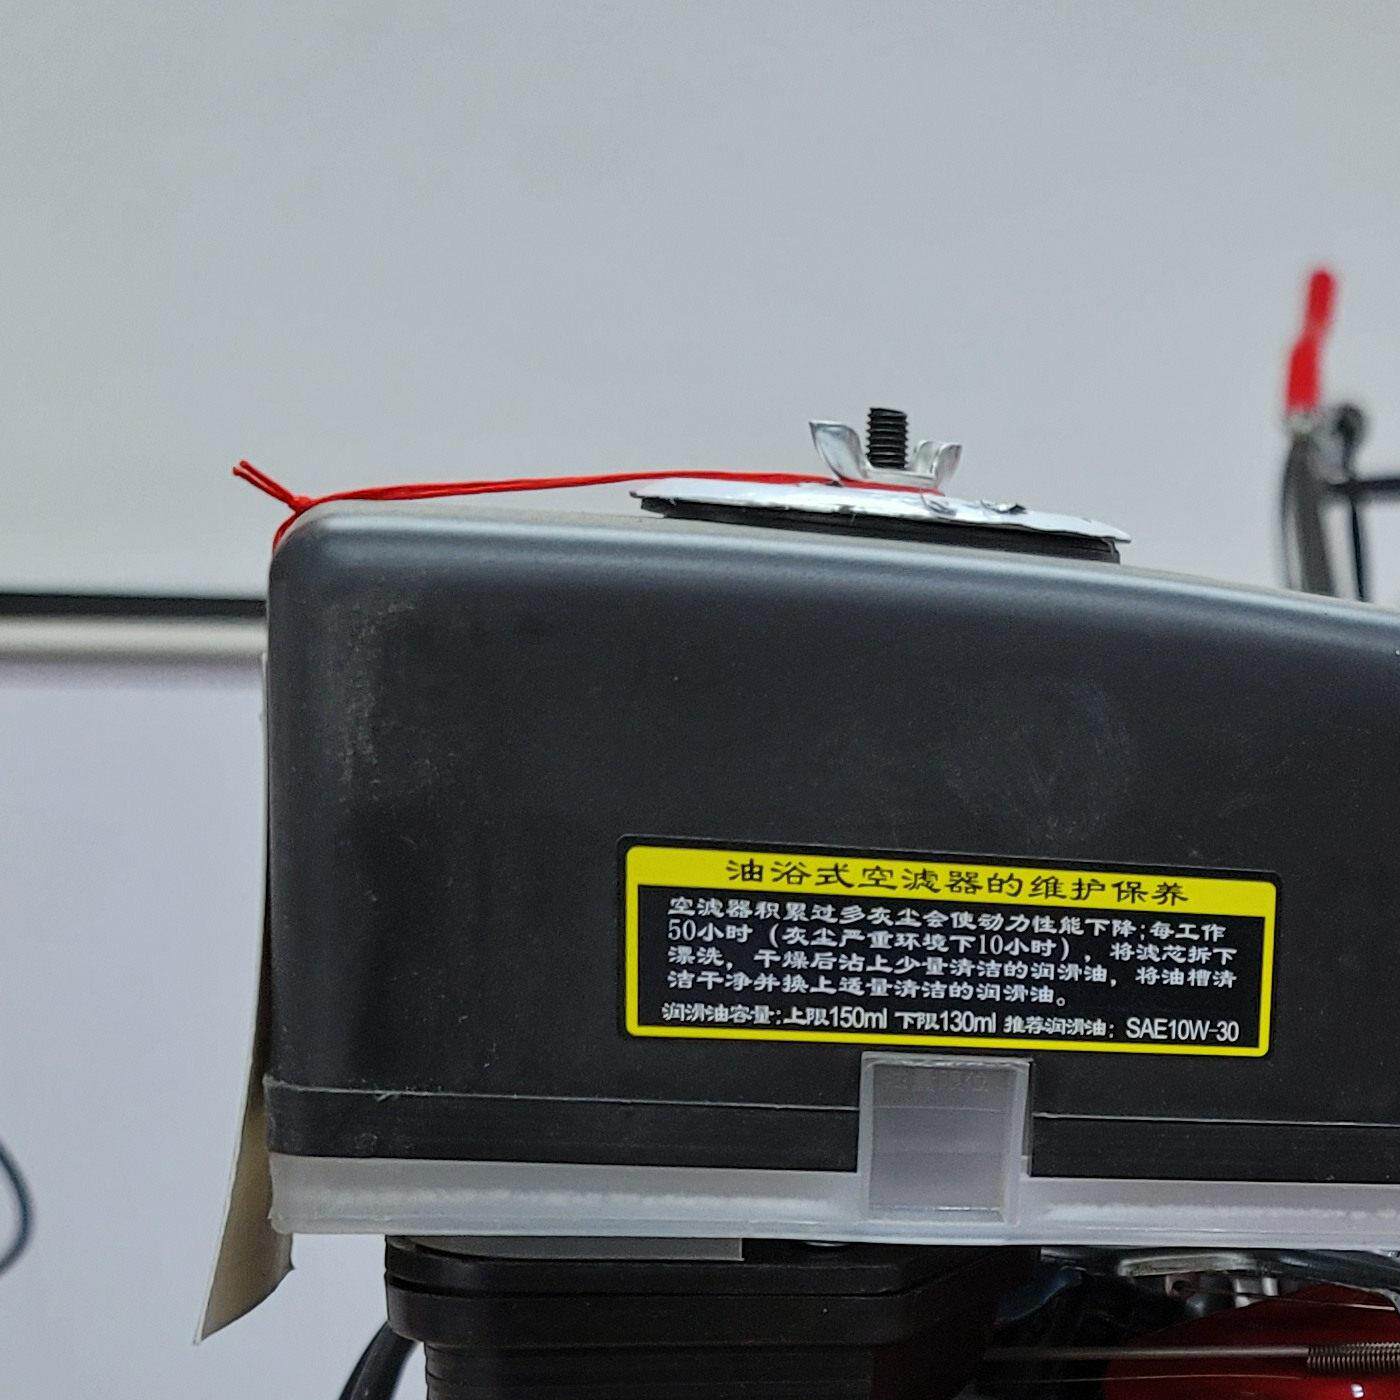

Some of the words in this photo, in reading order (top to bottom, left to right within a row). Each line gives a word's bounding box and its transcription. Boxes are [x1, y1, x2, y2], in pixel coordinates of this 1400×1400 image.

[725, 858, 1189, 907] 油浴式空滤器的维护保养
[894, 1009, 996, 1033] 下限130ml
[1126, 1017, 1240, 1042] SAE10W-30
